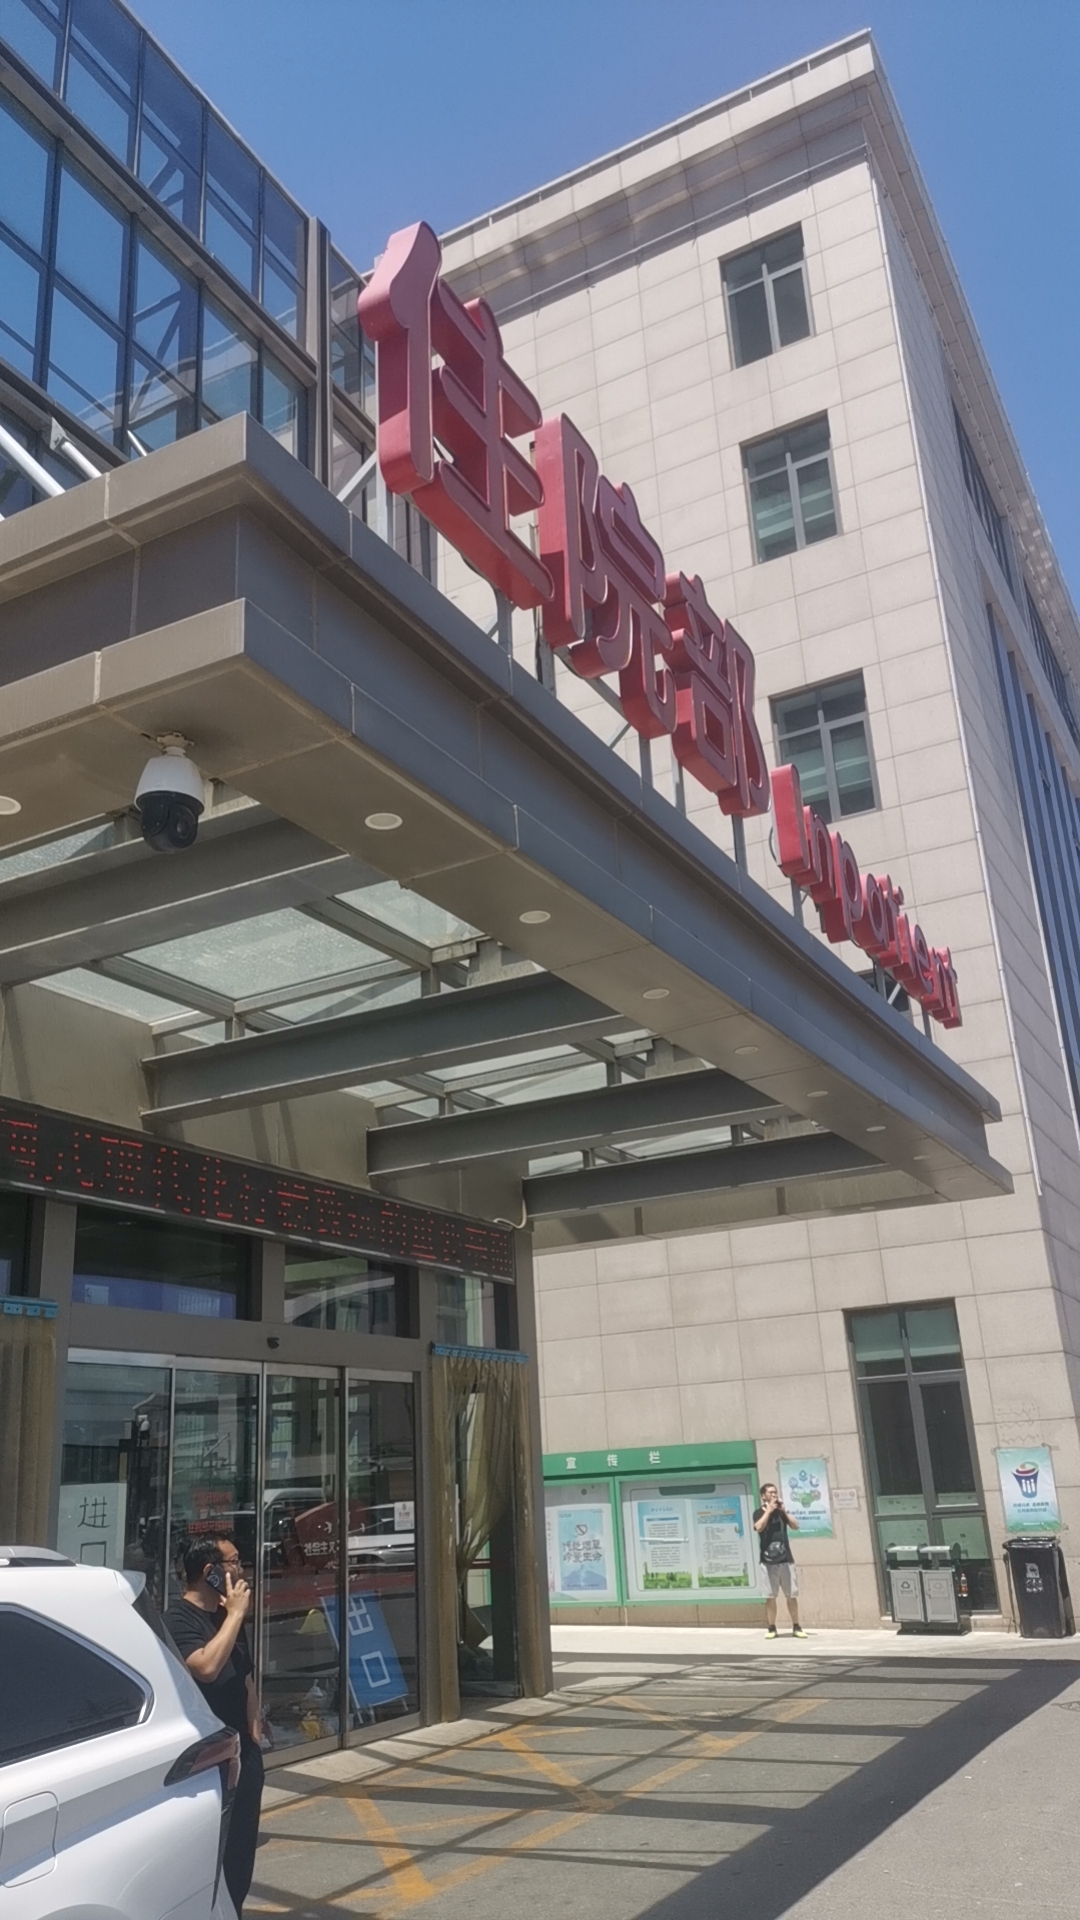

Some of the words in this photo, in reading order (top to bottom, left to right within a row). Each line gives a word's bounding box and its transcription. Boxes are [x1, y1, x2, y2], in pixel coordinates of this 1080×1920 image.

[358, 221, 771, 817] 住院部
[771, 763, 963, 1029] Inpatient
[566, 1451, 661, 1470] 宣传栏
[77, 1496, 110, 1567] 进口
[304, 1541, 340, 1556] 社会主义
[346, 1598, 391, 1688] 出口
